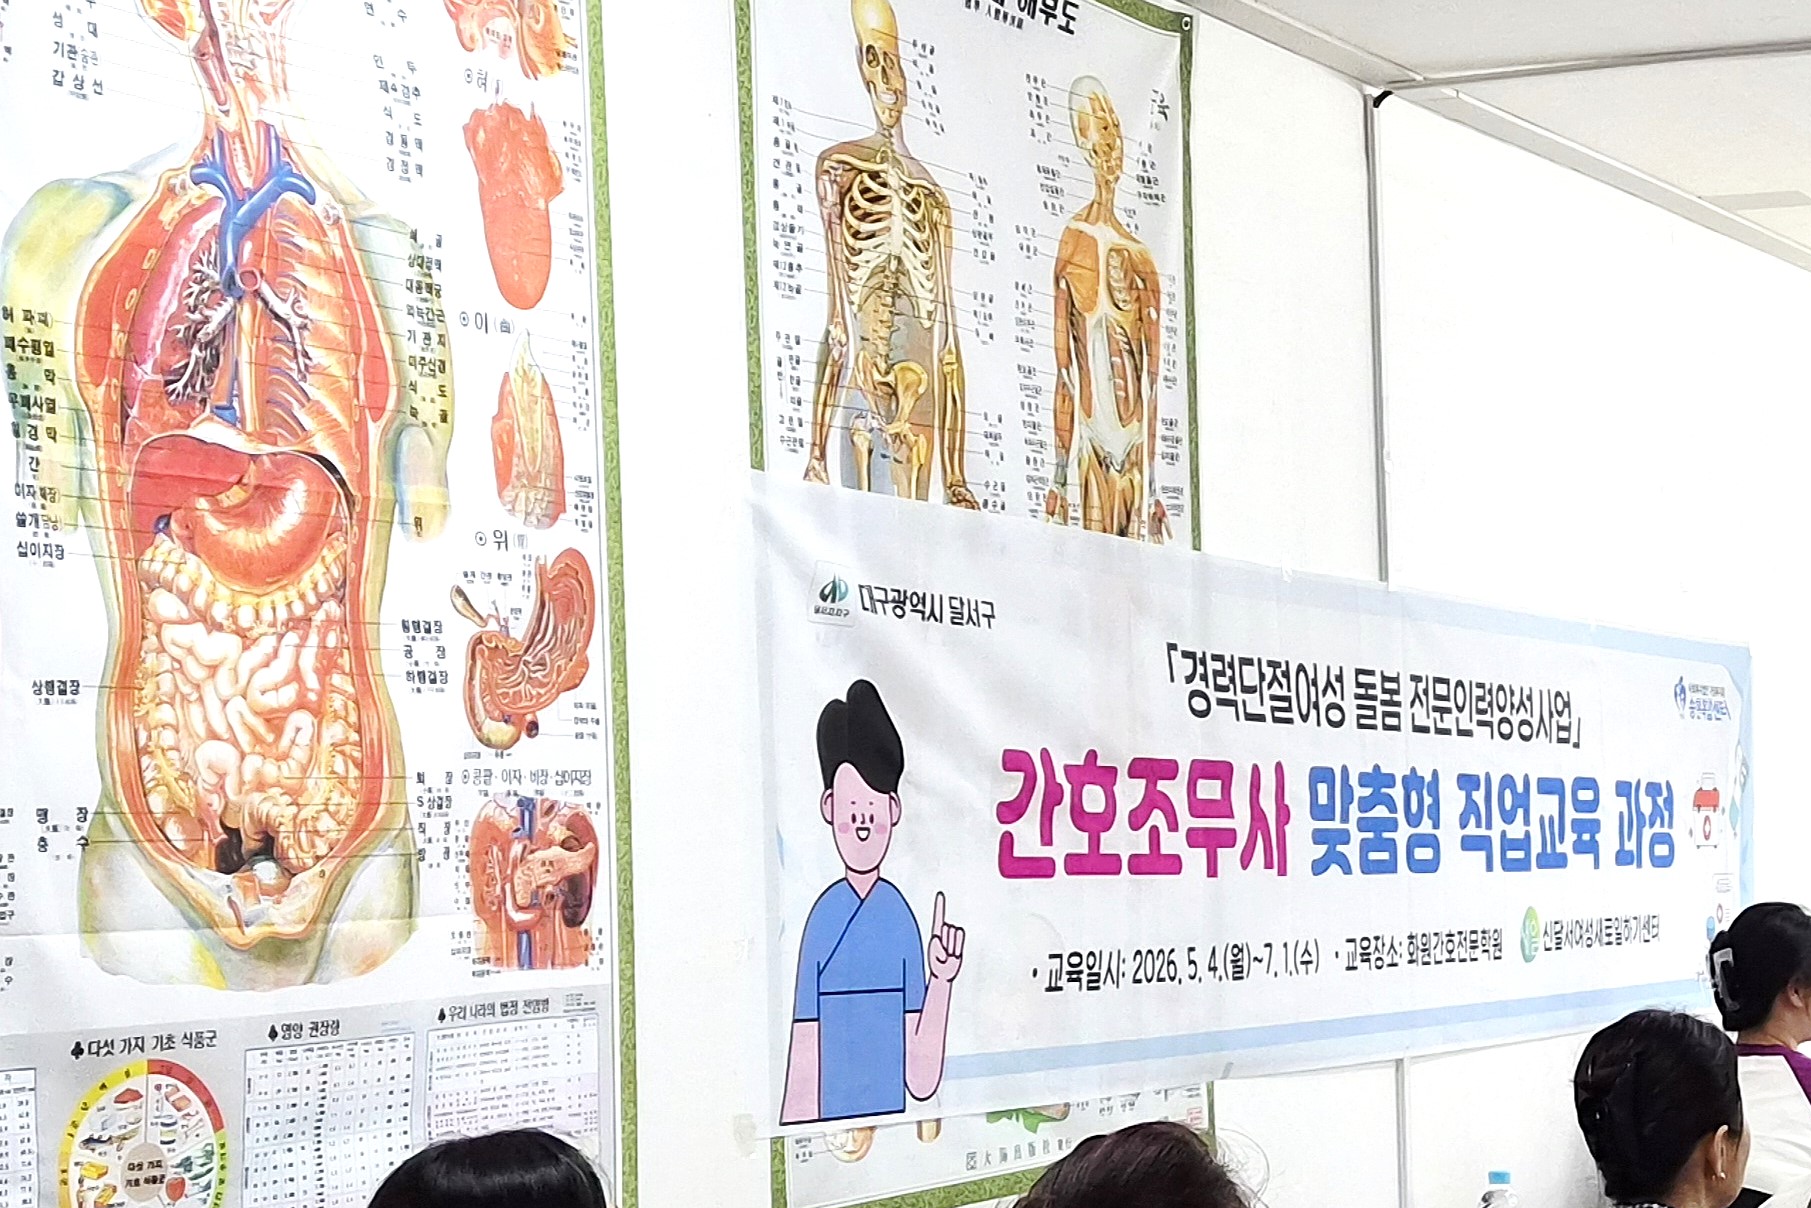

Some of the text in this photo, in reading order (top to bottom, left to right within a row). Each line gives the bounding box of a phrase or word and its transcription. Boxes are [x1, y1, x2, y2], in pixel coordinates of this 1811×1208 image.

[17, 541, 65, 560] 십이지장
[857, 583, 996, 630] 대구광역시 달서구
[1354, 671, 1402, 732] 돌봄
[996, 746, 1676, 878] 간호조무사 맞춤형 직업교육 과정
[1406, 928, 1503, 967] 화원간호전문학원
[1542, 913, 1661, 953] 신달서여성새로일하기센터
[88, 1040, 115, 1057] 다섯
[120, 1037, 146, 1053] 가지
[152, 1034, 175, 1051] 기초
